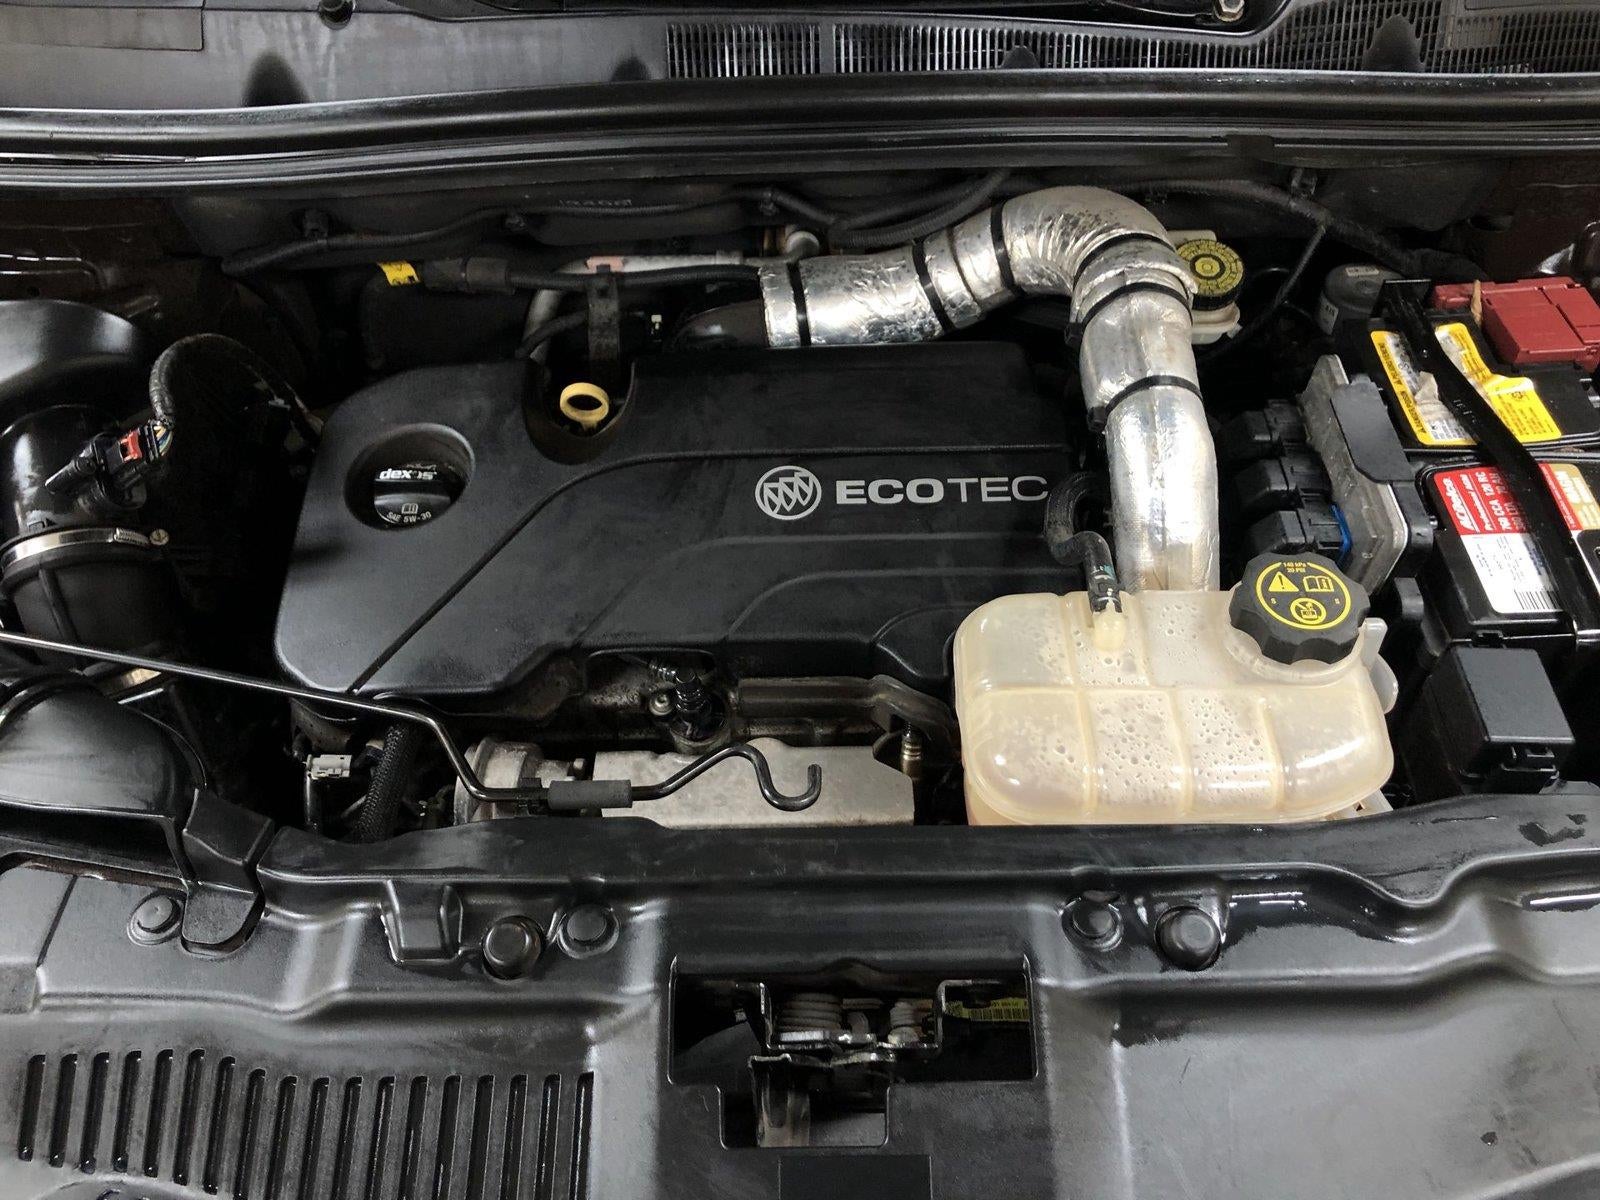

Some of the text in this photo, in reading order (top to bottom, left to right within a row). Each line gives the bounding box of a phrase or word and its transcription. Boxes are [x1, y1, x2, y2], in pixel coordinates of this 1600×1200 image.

[835, 476, 1049, 505] ECOTEC
[1442, 476, 1474, 529] ACDelco
[1489, 499, 1504, 516] CCA
[387, 512, 432, 523] SAE 5W-30
